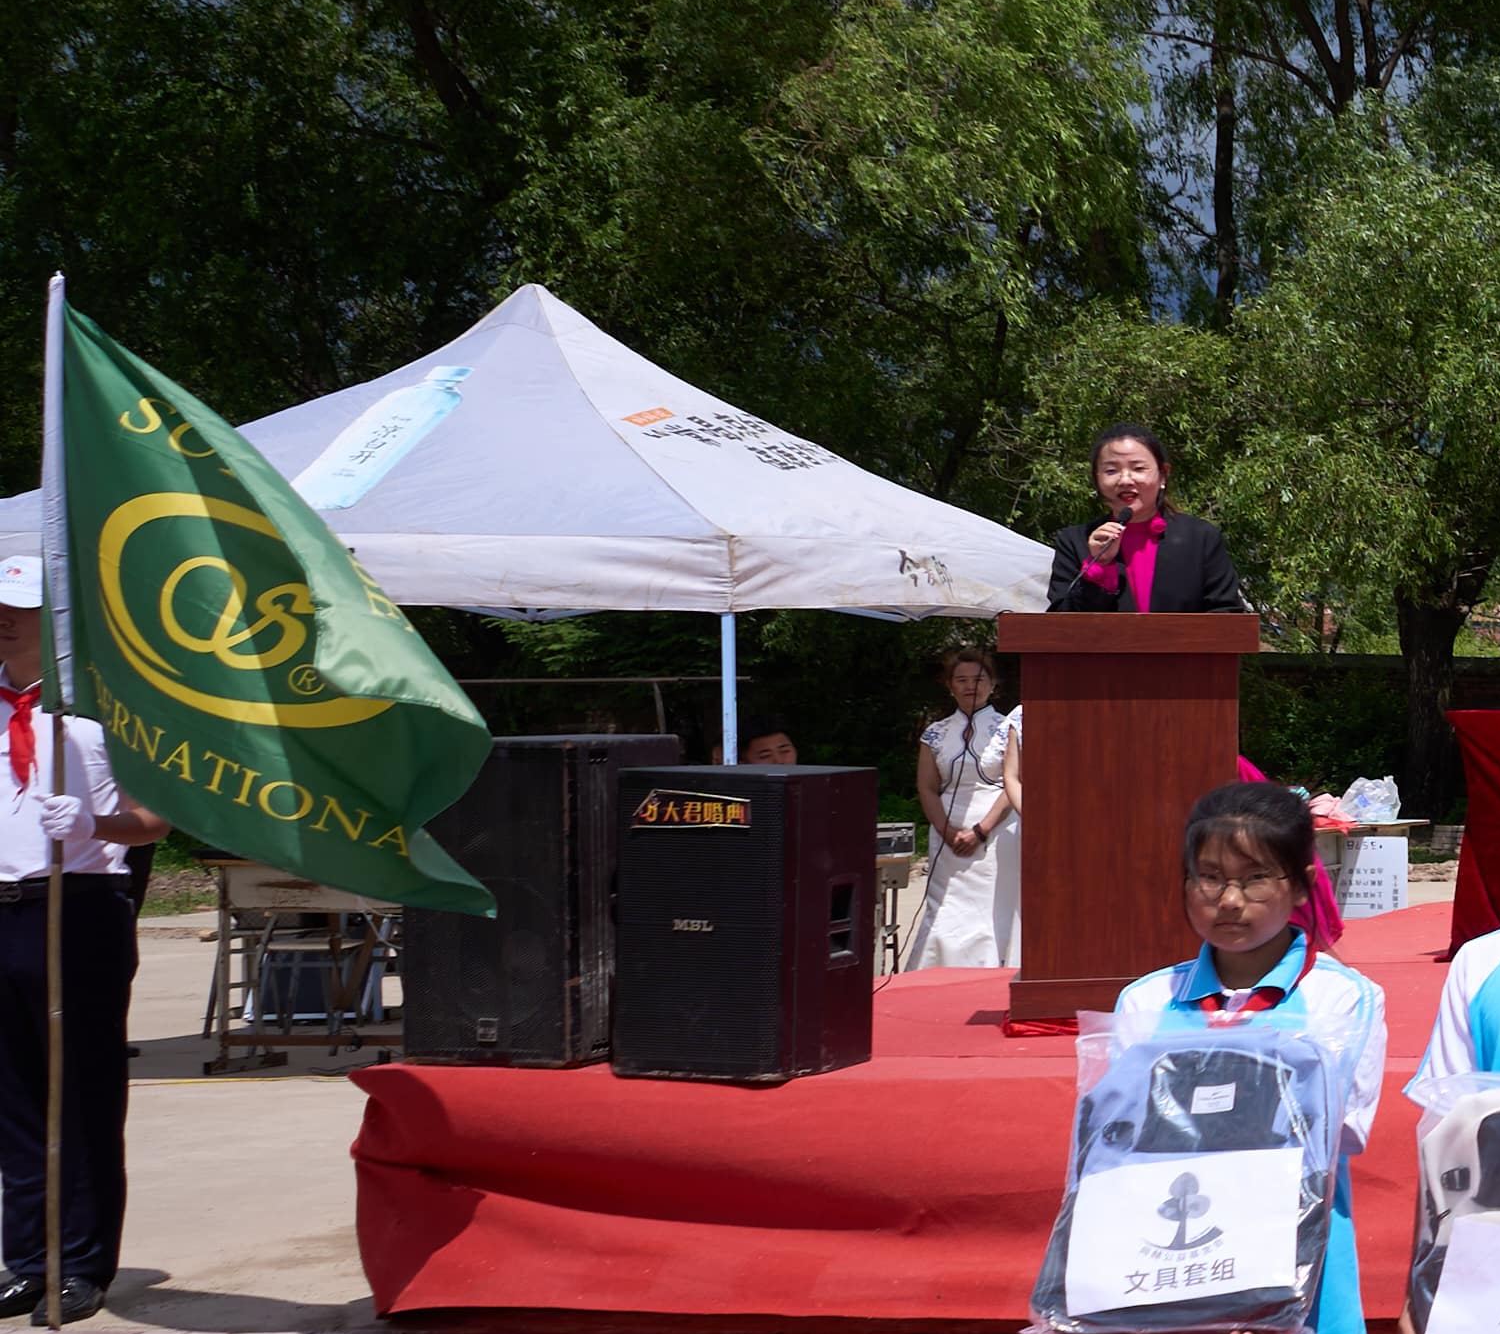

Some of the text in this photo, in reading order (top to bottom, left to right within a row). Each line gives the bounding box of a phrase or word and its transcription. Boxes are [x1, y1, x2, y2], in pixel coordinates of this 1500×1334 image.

[672, 919, 714, 932] MBL
[1124, 1257, 1236, 1295] 文具套组
